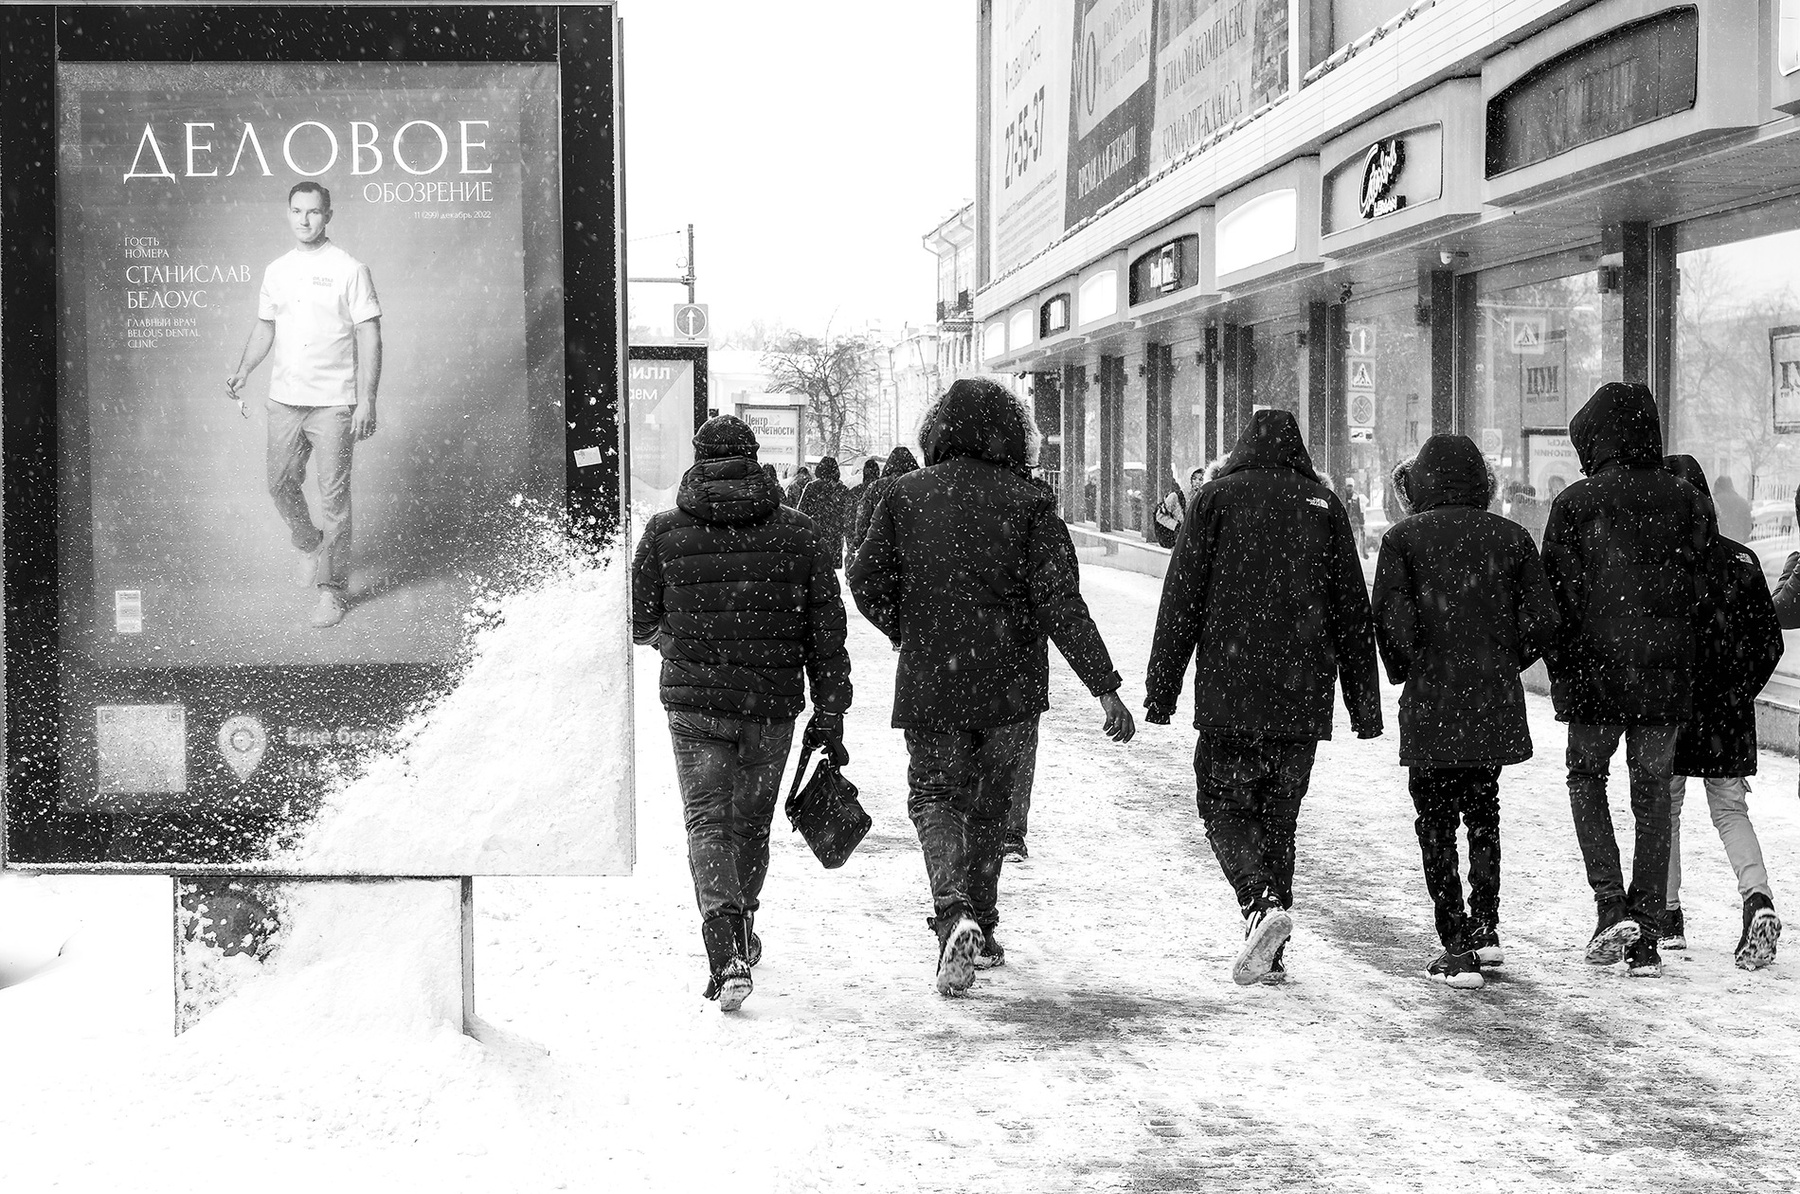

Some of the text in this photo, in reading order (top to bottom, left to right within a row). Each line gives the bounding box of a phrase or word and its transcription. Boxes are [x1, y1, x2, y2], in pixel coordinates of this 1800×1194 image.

[123, 120, 494, 184] ДЕЛОВОЕ
[363, 181, 494, 203] ОБОЗРЕНИЕ
[440, 210, 472, 220] декабрь
[473, 210, 492, 219] 2022
[124, 237, 160, 247] ГОСТЬ
[125, 249, 170, 259] НОМЕРА
[126, 264, 251, 284] СТАНИСЛАВ
[127, 290, 208, 309] БЕЛОУС
[127, 318, 196, 327] ГЛАВНЫЙ ВРАЧ
[127, 329, 201, 338] BELOUS DENTAL
[127, 340, 159, 349] CLINIC
[745, 414, 769, 428] Центр
[752, 426, 795, 436] отчетности
